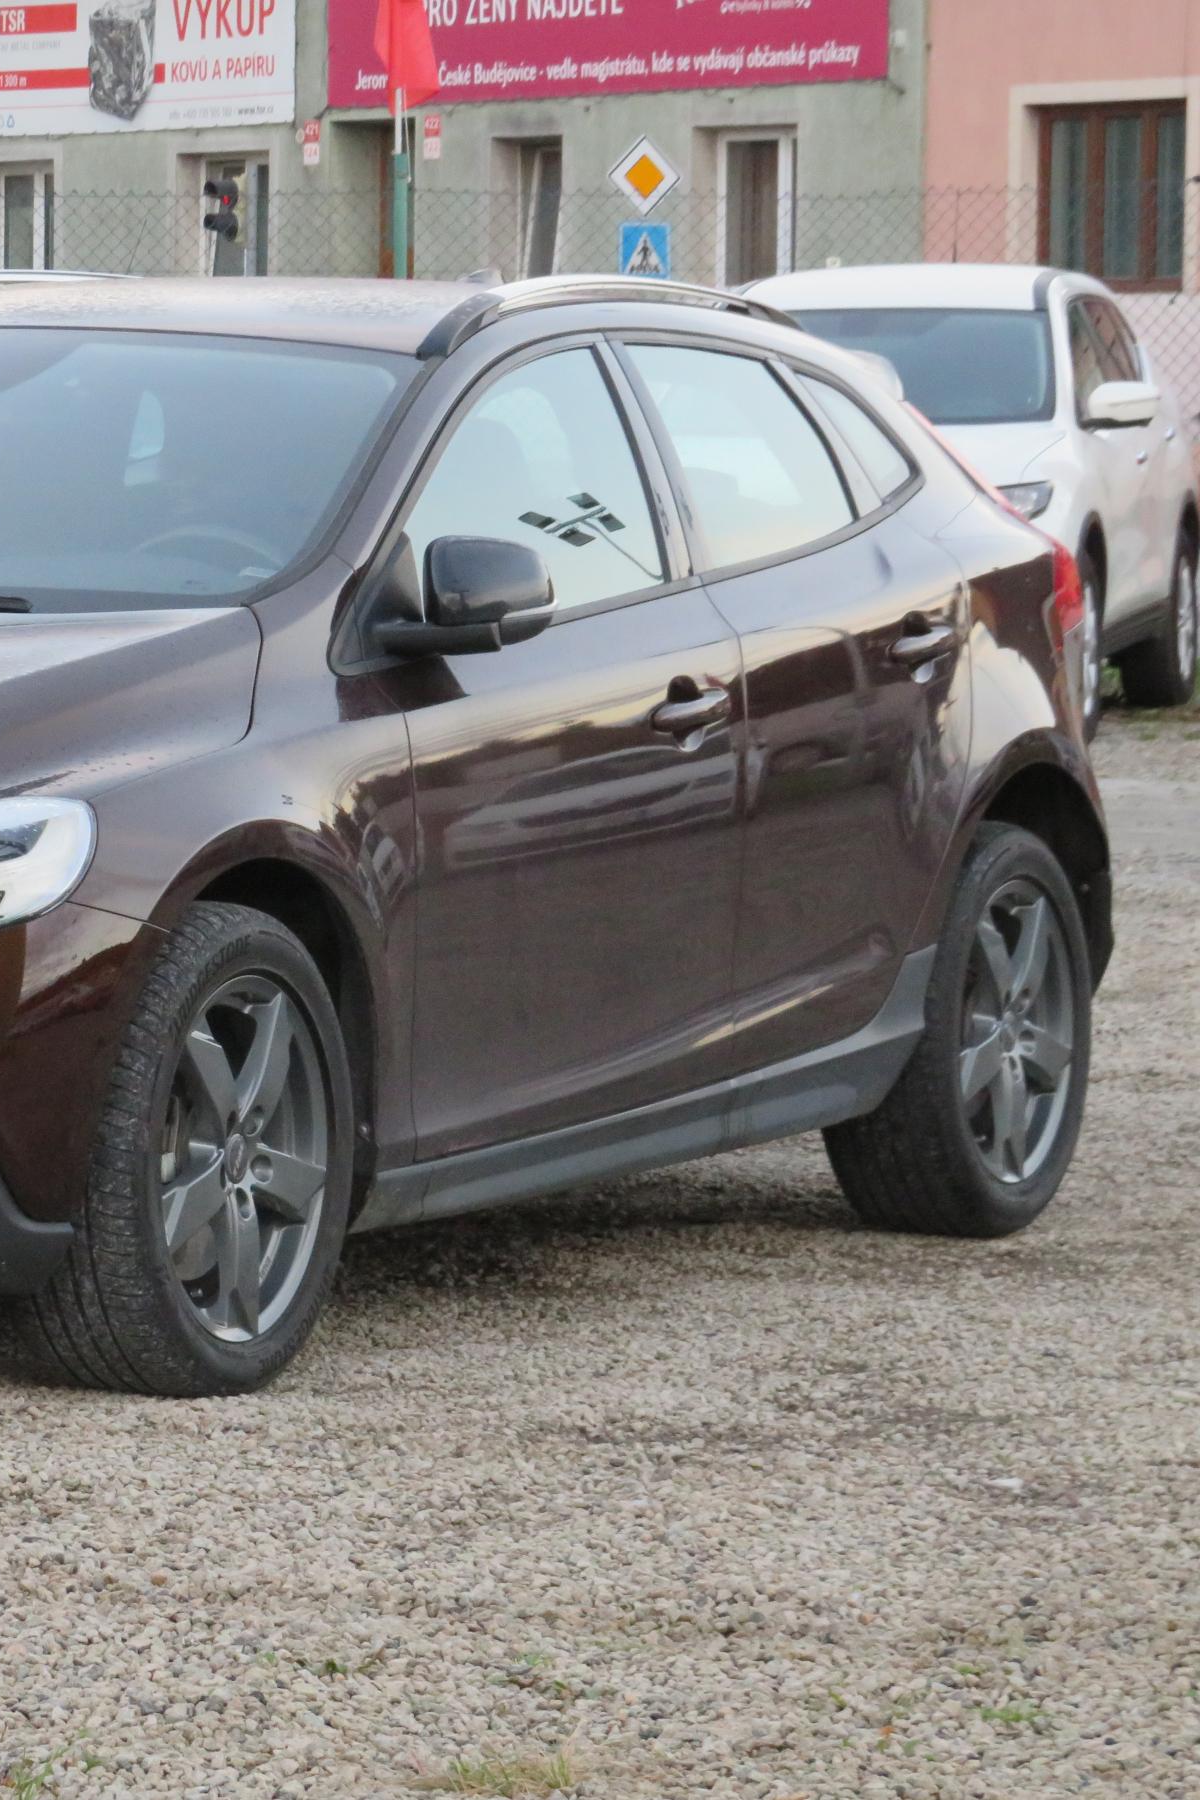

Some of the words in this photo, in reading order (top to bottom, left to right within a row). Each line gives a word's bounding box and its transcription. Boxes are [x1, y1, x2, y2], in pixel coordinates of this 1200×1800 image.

[0, 9, 26, 32] TSR
[422, 0, 457, 27] RO
[212, 59, 222, 80] A
[226, 52, 275, 79] PAPÍRU
[438, 60, 471, 87] České
[474, 61, 536, 88] Budějovice
[547, 56, 577, 80] vedle
[581, 52, 648, 82] magistrátu,
[651, 50, 674, 73] kde
[677, 56, 690, 72] se
[694, 45, 744, 75] vydávají
[747, 42, 805, 68] občanské
[808, 39, 861, 71] průkazy
